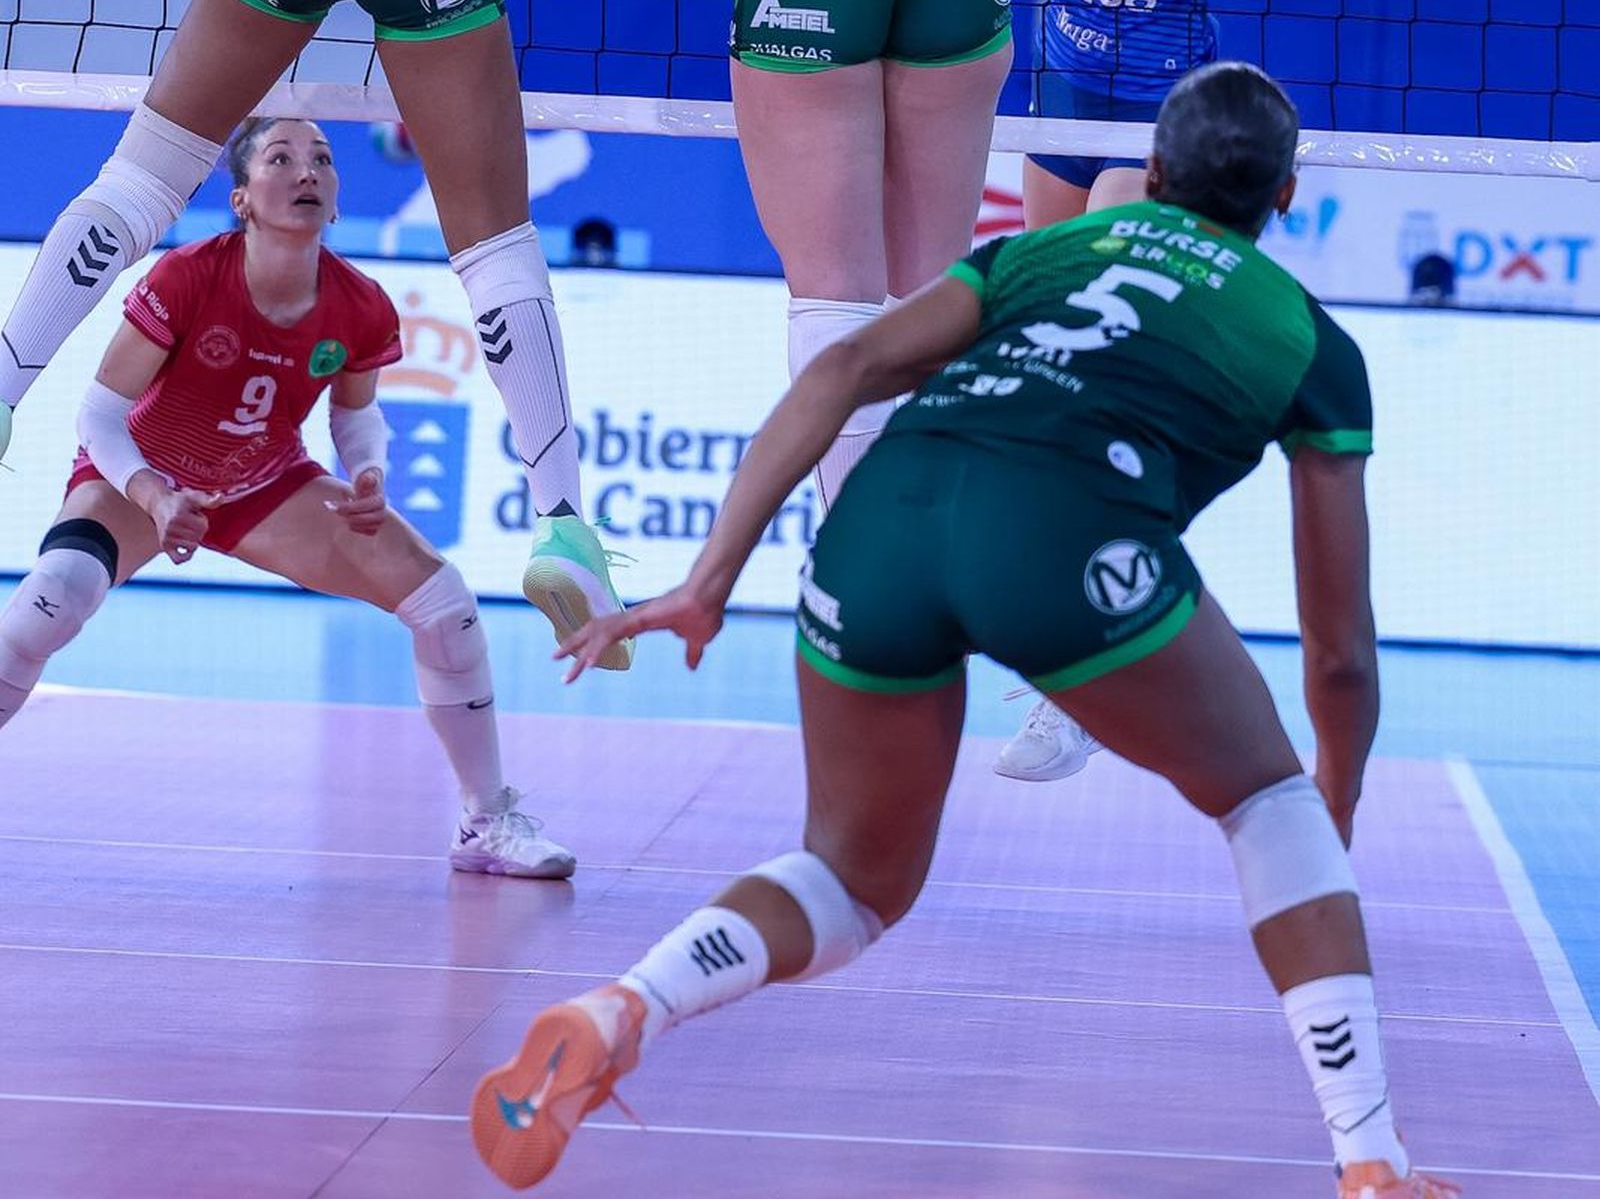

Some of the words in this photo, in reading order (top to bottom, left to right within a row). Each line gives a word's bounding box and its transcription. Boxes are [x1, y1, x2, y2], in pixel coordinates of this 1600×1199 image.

[1108, 218, 1234, 273] BURSE
[1456, 231, 1593, 283] DXT
[1021, 263, 1184, 351] 5
[234, 375, 278, 423] 9
[501, 408, 758, 474] bier
